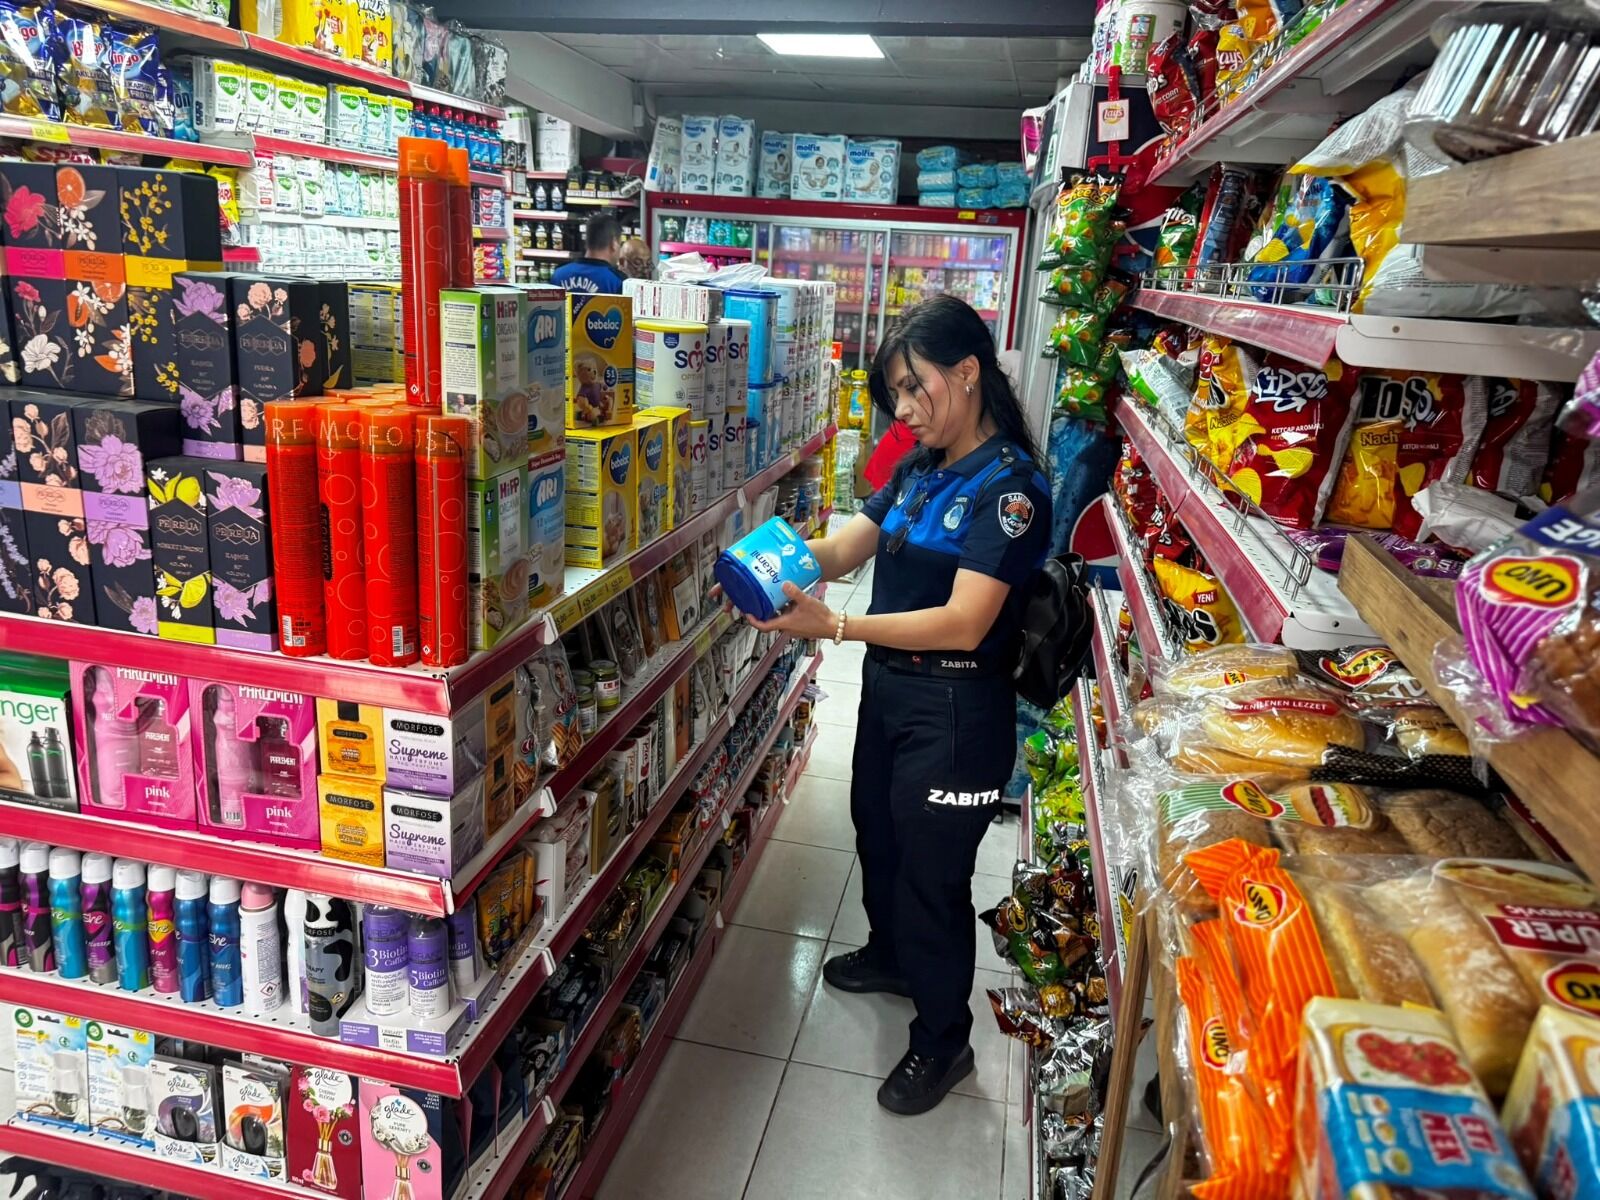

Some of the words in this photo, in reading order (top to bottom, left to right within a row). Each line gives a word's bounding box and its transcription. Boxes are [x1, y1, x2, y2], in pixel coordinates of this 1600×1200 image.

[849, 149, 875, 158] molfix
[587, 318, 620, 330] bebelac
[622, 389, 631, 404] 3
[751, 550, 781, 584] Aptamil
[1504, 565, 1567, 598] UNO
[1197, 592, 1214, 602] YENİ
[941, 660, 978, 669] ZABITA
[1292, 700, 1327, 711] LEZZET
[396, 721, 440, 734] MORFOSE
[389, 739, 448, 762] Supreme
[145, 786, 170, 799] pink
[928, 789, 999, 806] ZABITA
[329, 796, 370, 809] MORFOSE
[266, 805, 292, 819] pink
[396, 807, 438, 820] MORFOSE
[389, 824, 446, 846] Supreme
[1247, 886, 1272, 921] UNO
[368, 949, 379, 967] 3
[411, 970, 418, 986] 5
[419, 969, 445, 981] Biotin
[168, 1077, 195, 1092] glade
[314, 1069, 343, 1085] glade
[240, 1086, 264, 1101] glade
[384, 1102, 416, 1119] glade
